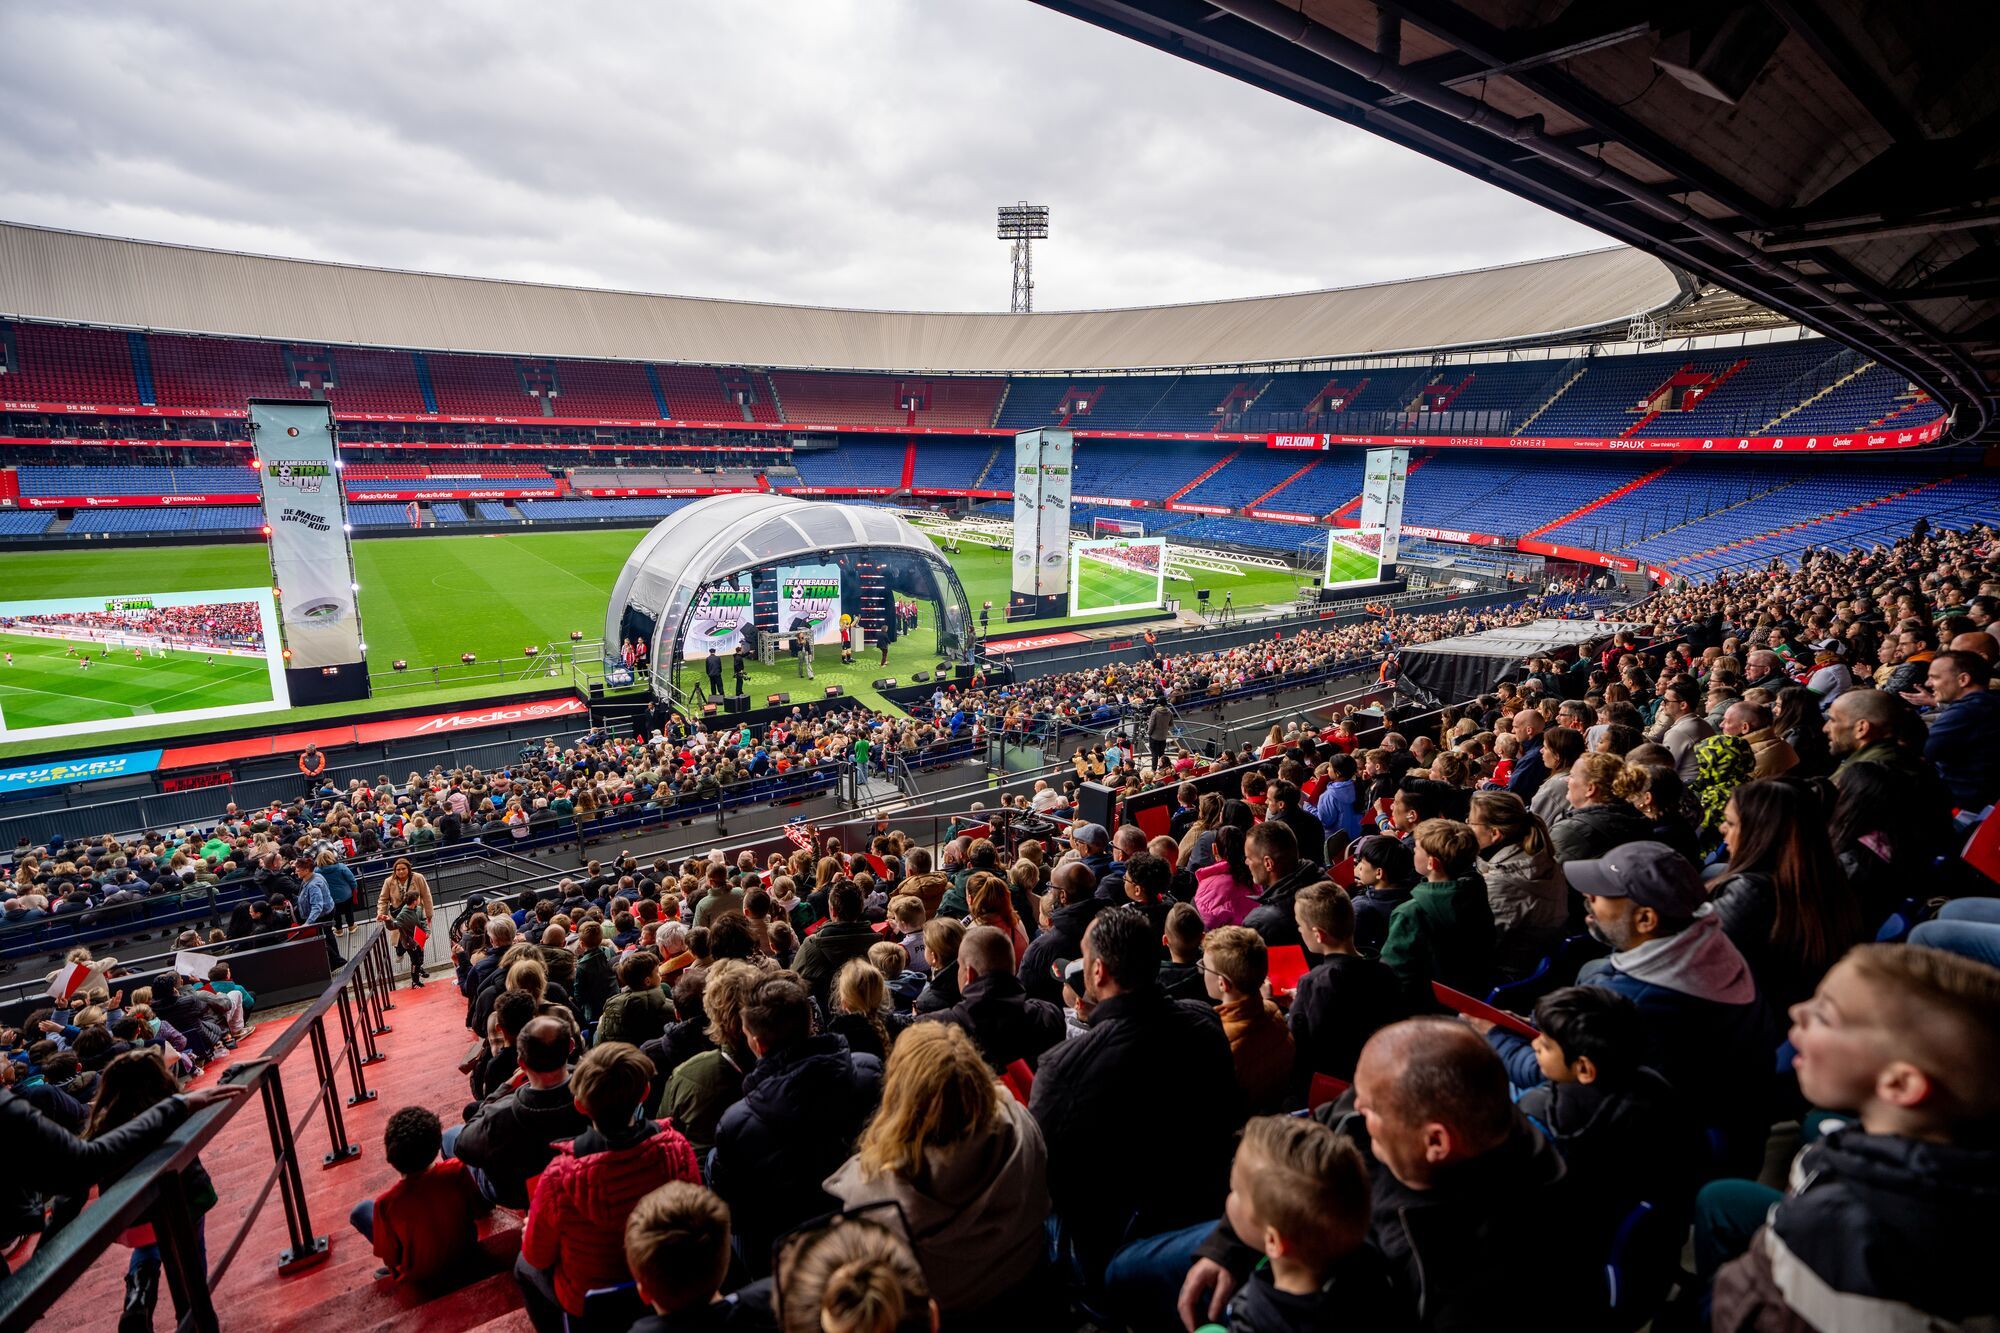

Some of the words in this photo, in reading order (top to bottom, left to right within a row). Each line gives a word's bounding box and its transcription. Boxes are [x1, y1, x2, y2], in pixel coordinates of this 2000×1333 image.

[1275, 436, 1315, 447] WELKOM
[1609, 440, 1645, 449] SPAUX
[1702, 440, 1713, 449] AD
[1738, 440, 1749, 449] AD
[1772, 440, 1783, 449] AD
[1806, 438, 1817, 449] AD
[279, 475, 323, 488] SHOW
[295, 509, 326, 524] MAGIE
[307, 521, 331, 532] KUIP
[1437, 529, 1471, 543] TRIBUNE
[790, 598, 831, 612] SHOW
[695, 605, 742, 622] SHOW
[415, 710, 522, 732] Media
[26, 766, 124, 784] vakanties
